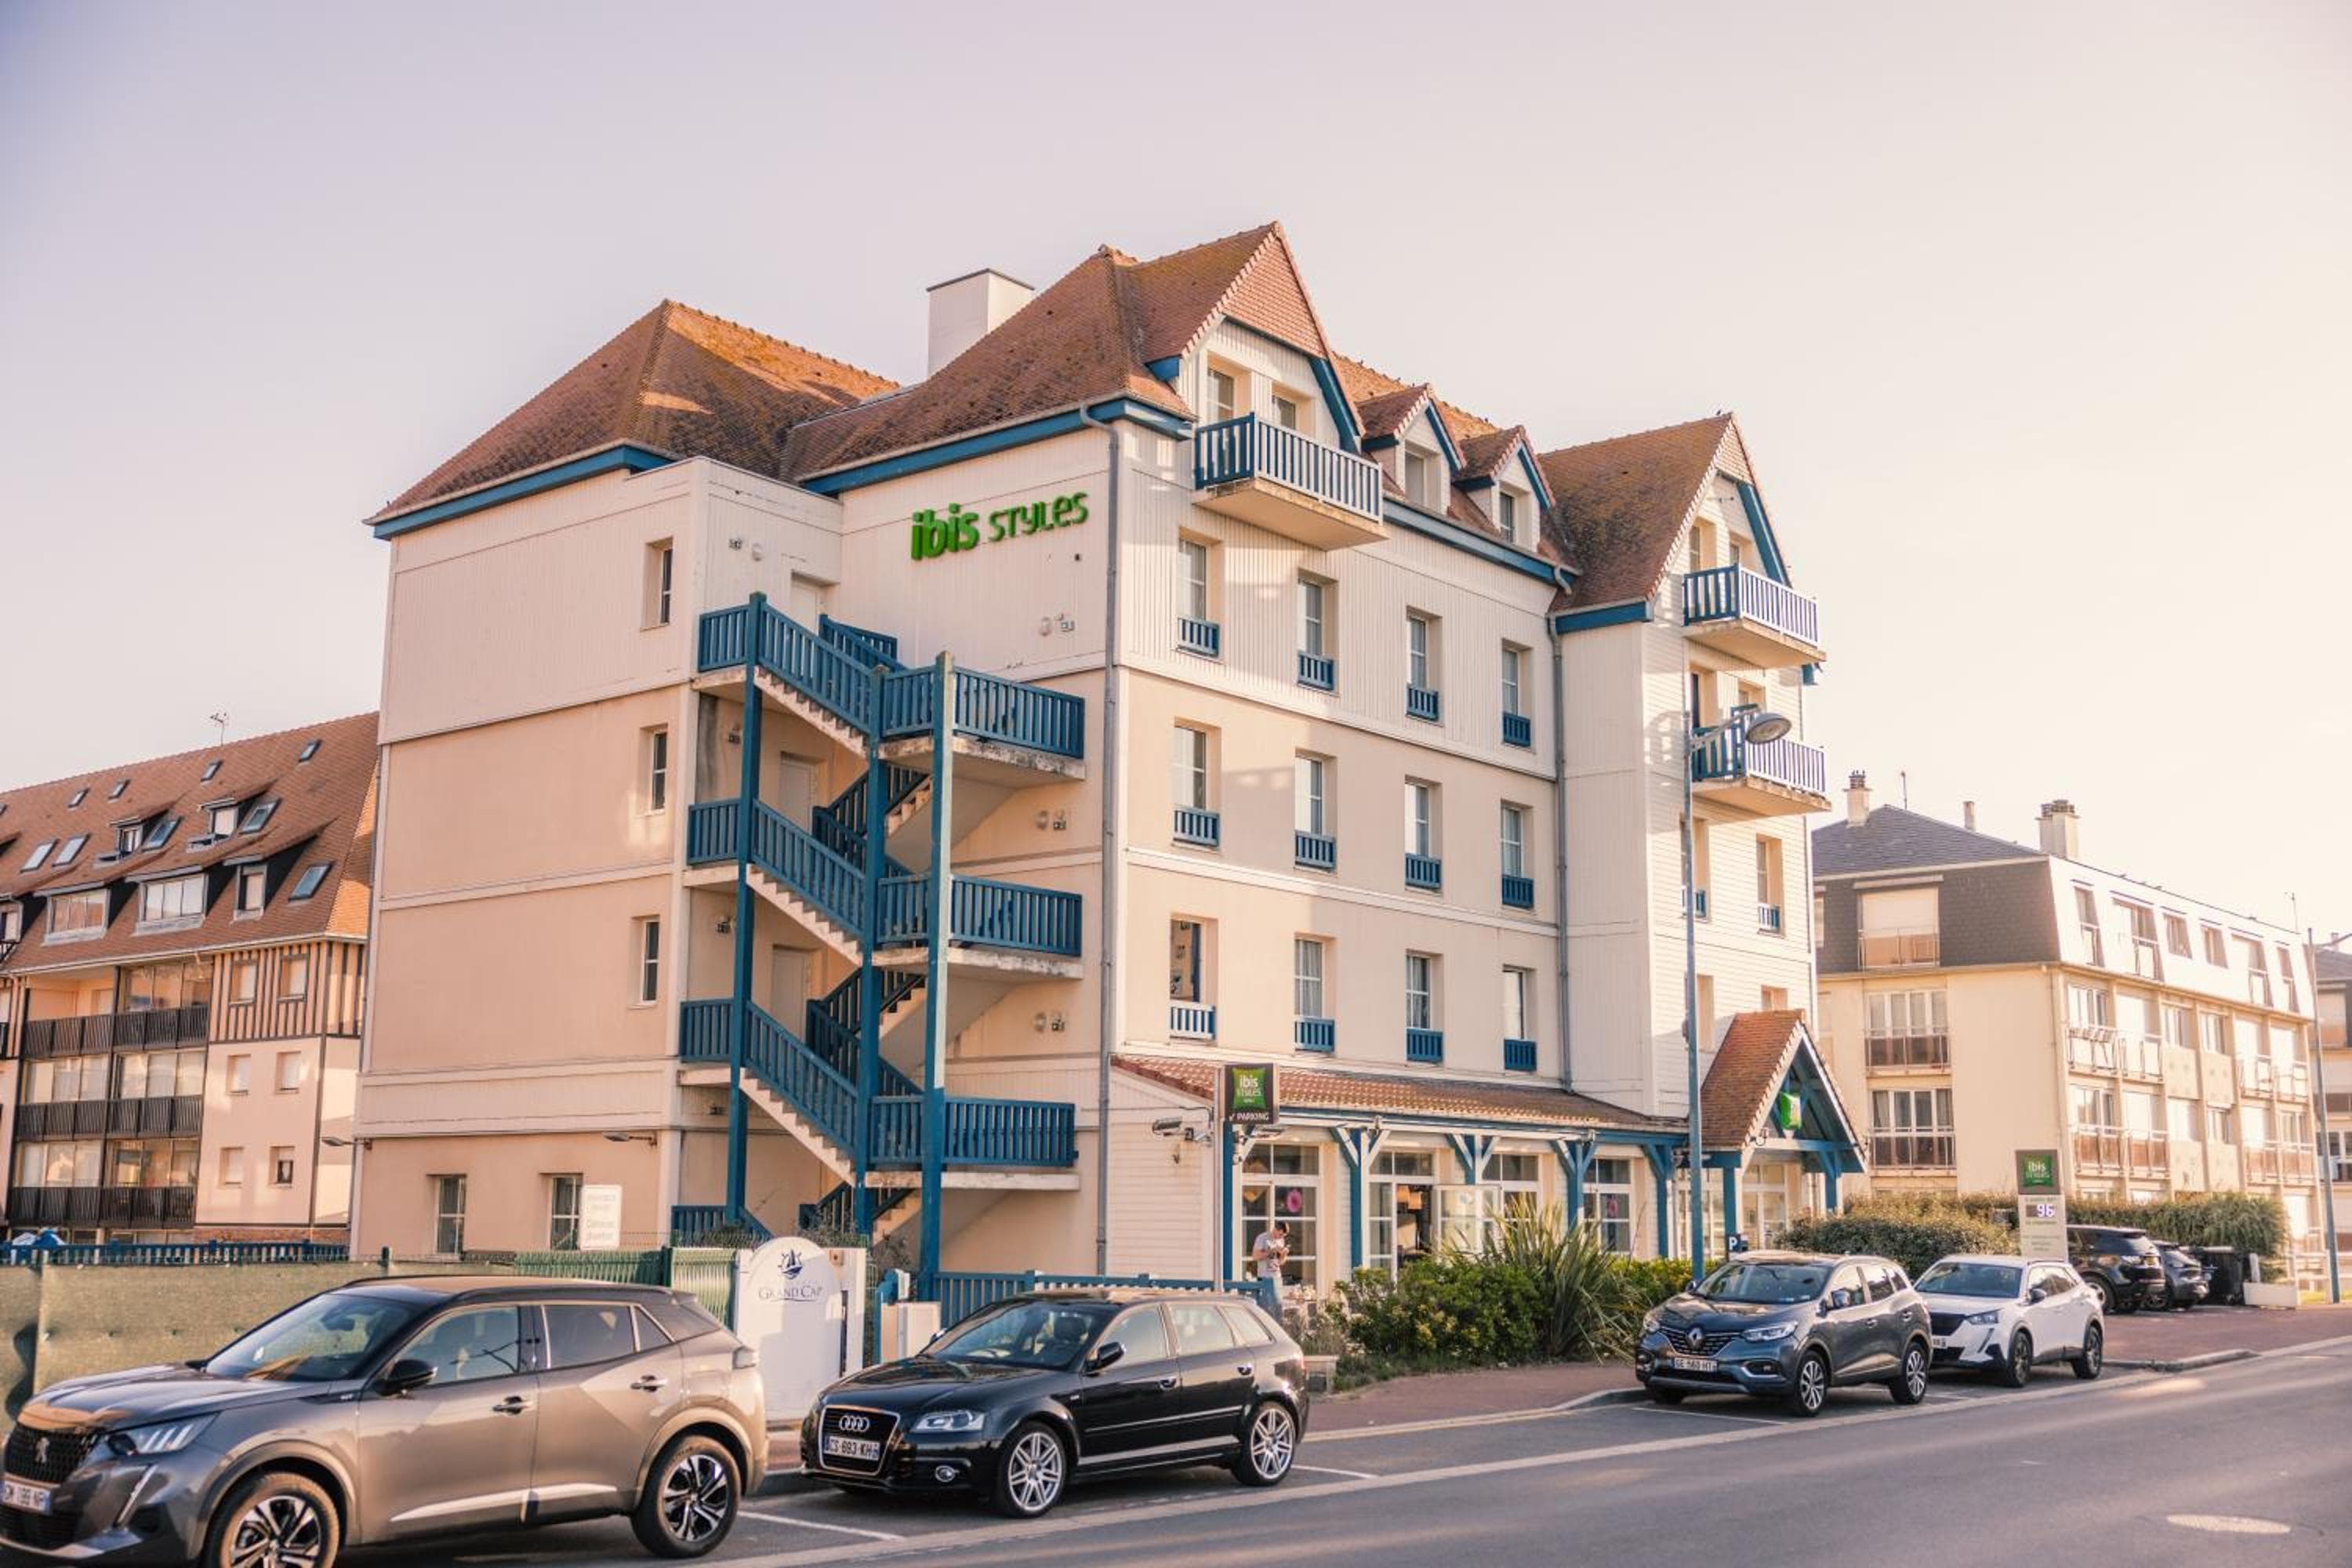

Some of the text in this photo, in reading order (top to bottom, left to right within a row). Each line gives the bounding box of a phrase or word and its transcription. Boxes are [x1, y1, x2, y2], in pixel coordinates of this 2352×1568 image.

[910, 503, 980, 561] ibis
[1240, 1074, 1258, 1088] ibis
[2027, 1160, 2046, 1172] ibis
[2037, 1203, 2056, 1218] 96
[1729, 1236, 1738, 1250] P
